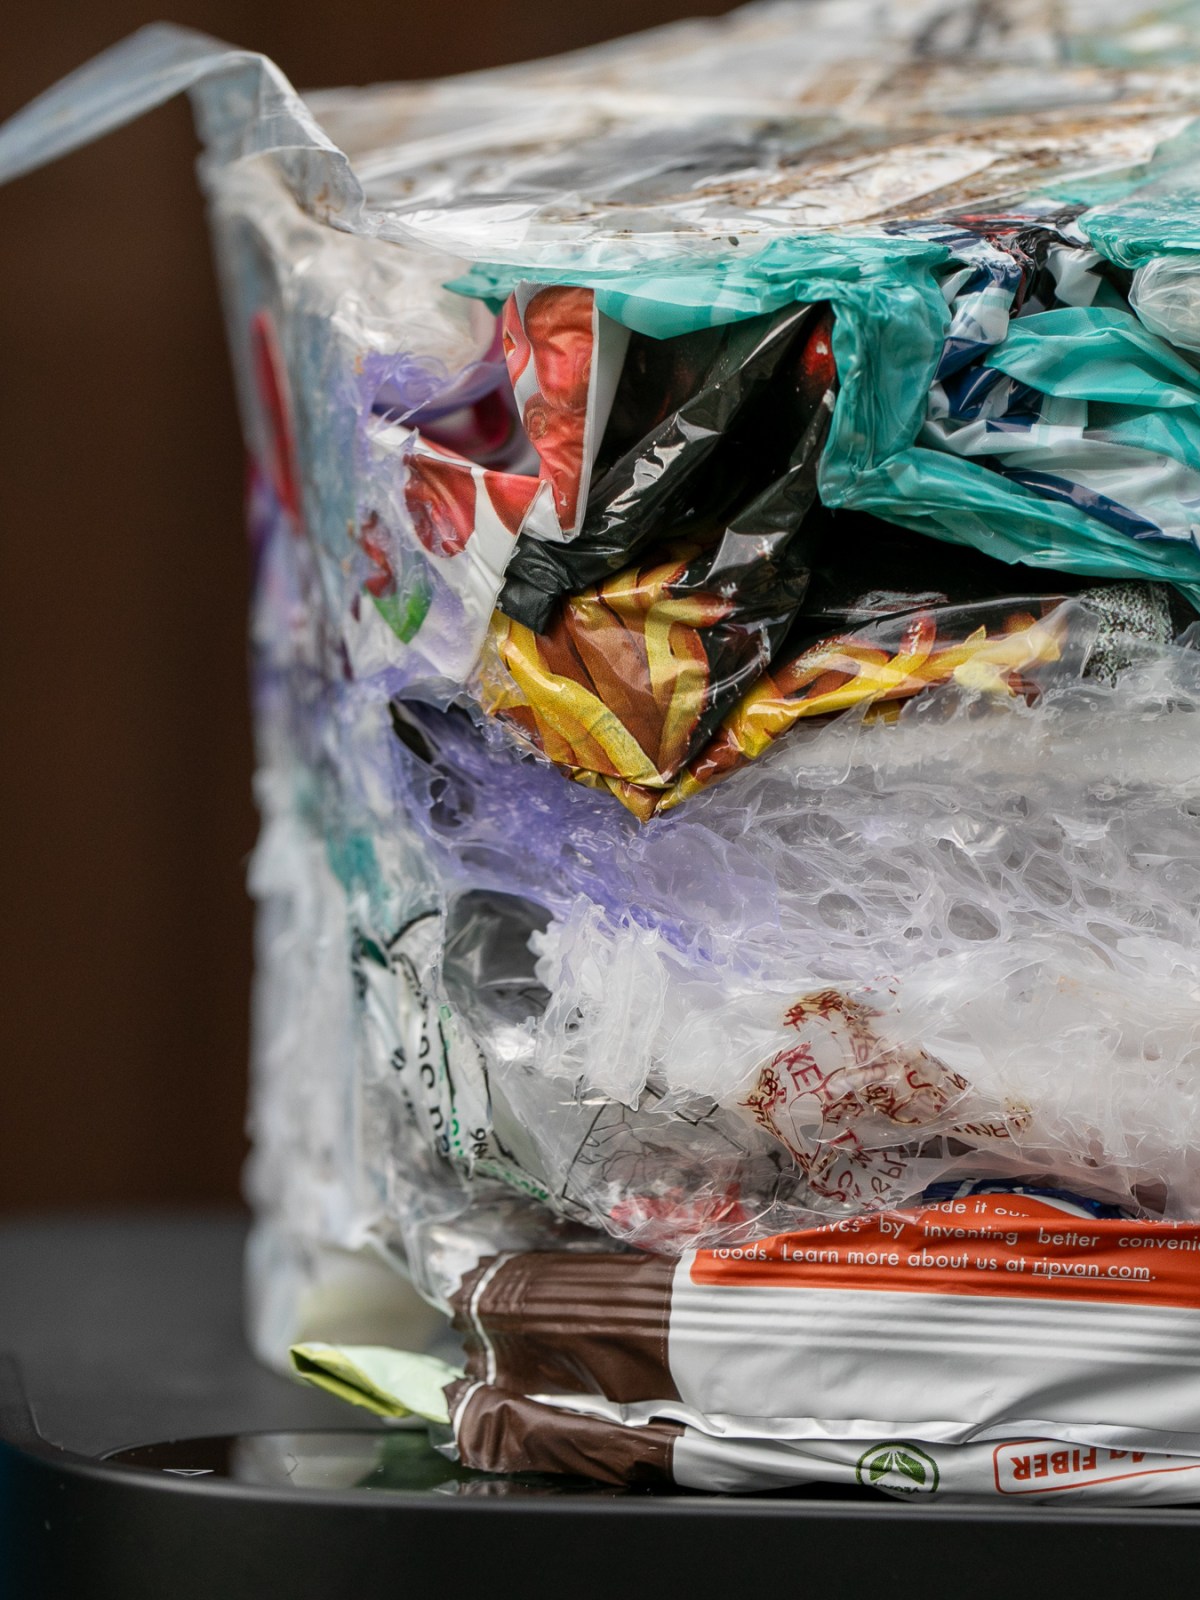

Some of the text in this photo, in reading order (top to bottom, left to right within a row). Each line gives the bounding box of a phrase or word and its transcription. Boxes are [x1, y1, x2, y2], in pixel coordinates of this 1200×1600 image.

[915, 1200, 967, 1214] ade
[974, 1200, 988, 1214] it
[879, 1214, 905, 1239] by
[923, 1220, 1018, 1246] inventing
[1038, 1227, 1100, 1247] better
[781, 1243, 839, 1264] Learn
[847, 1251, 900, 1266] more
[907, 1247, 969, 1269] about
[975, 1257, 998, 1270] us
[1005, 1256, 1026, 1272] at
[1033, 1257, 1157, 1280] ripvan.com.
[1009, 1446, 1098, 1481] FIBER
